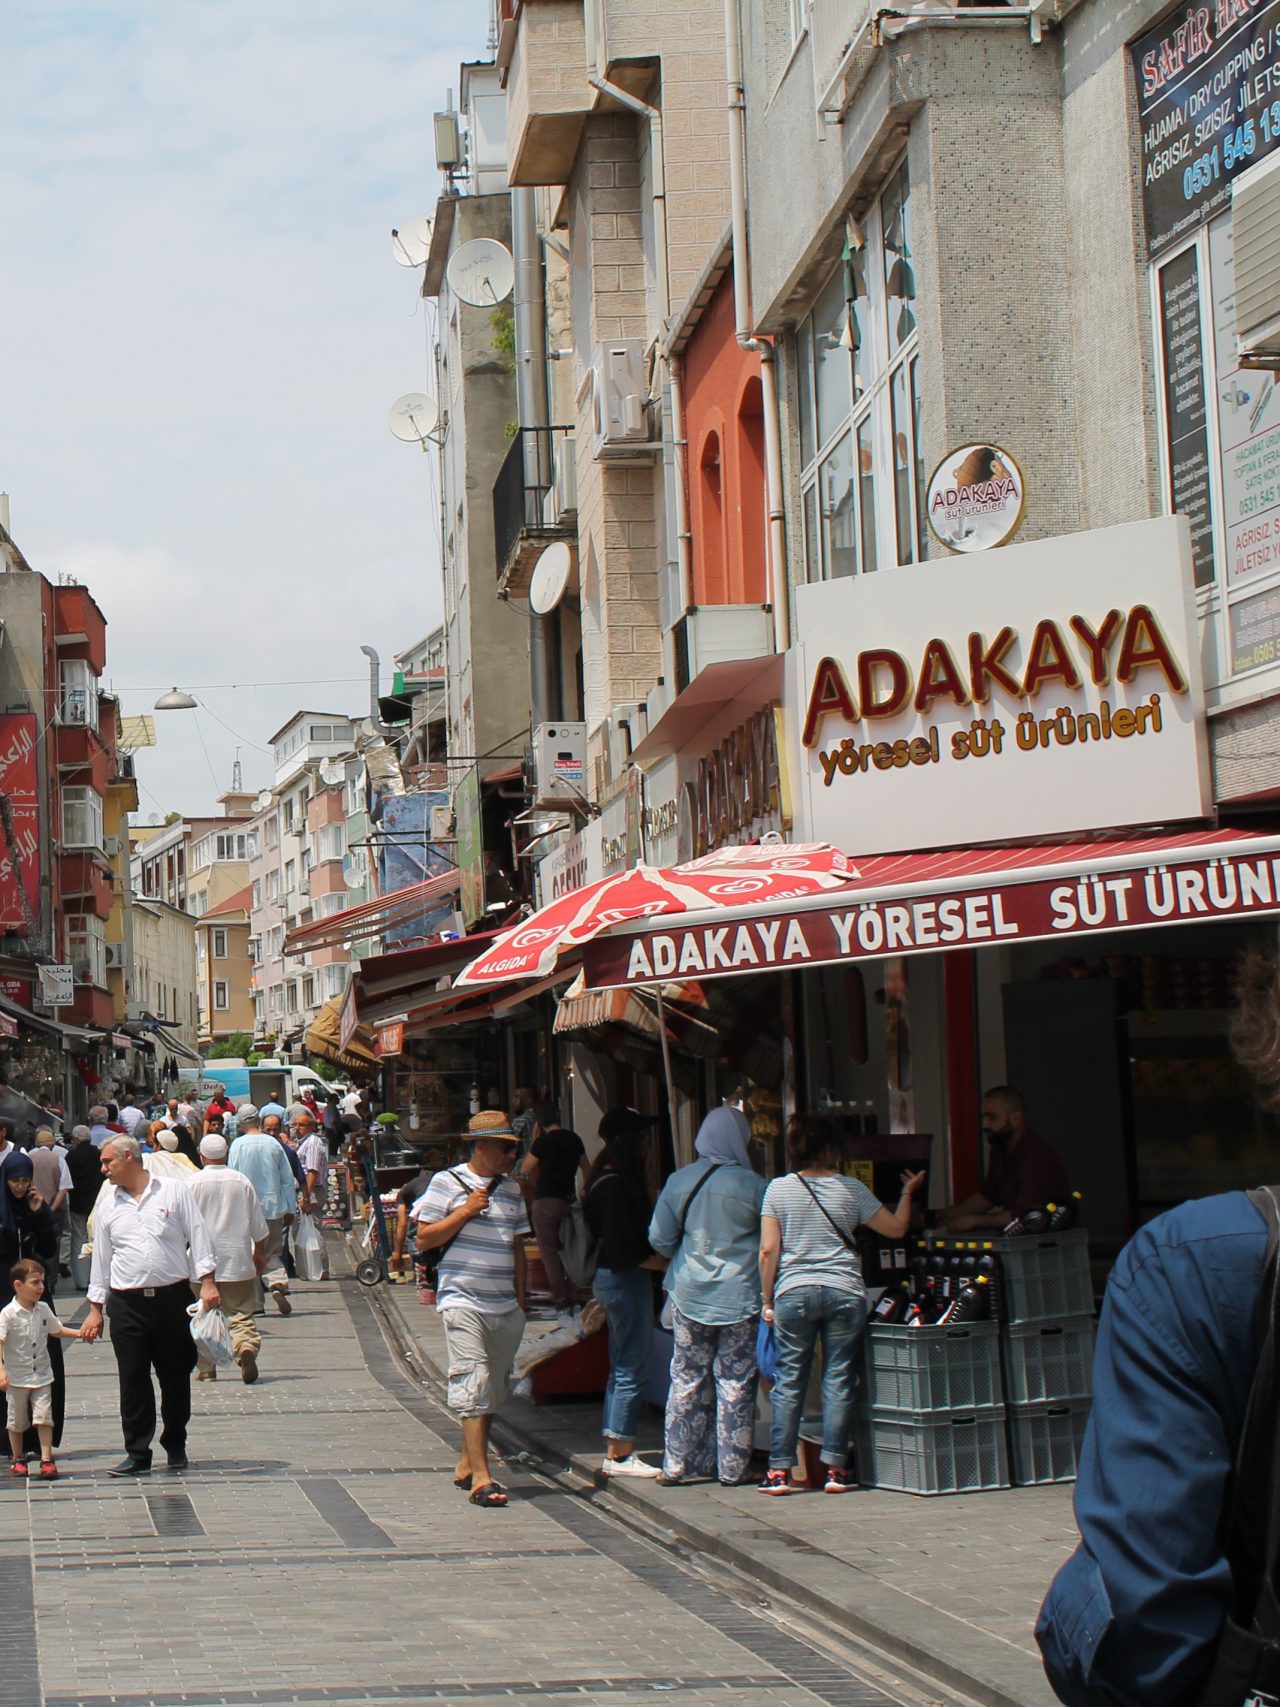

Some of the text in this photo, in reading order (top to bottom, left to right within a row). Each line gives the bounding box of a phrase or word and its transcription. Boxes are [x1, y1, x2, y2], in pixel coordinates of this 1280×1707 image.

[1189, 81, 1211, 117] DRY
[1213, 37, 1265, 96] CUPPING
[1183, 145, 1220, 200] 0531
[1224, 118, 1257, 169] 545
[931, 478, 1021, 514] ADAKAYA
[1239, 495, 1258, 516] 0531
[802, 604, 1189, 749] ADAKAYA
[820, 694, 1163, 787] yöresel süt ürünleri
[625, 918, 811, 979] ADAKAYA
[829, 893, 1019, 954] YÖRESEL
[1049, 873, 1133, 930] SÜT
